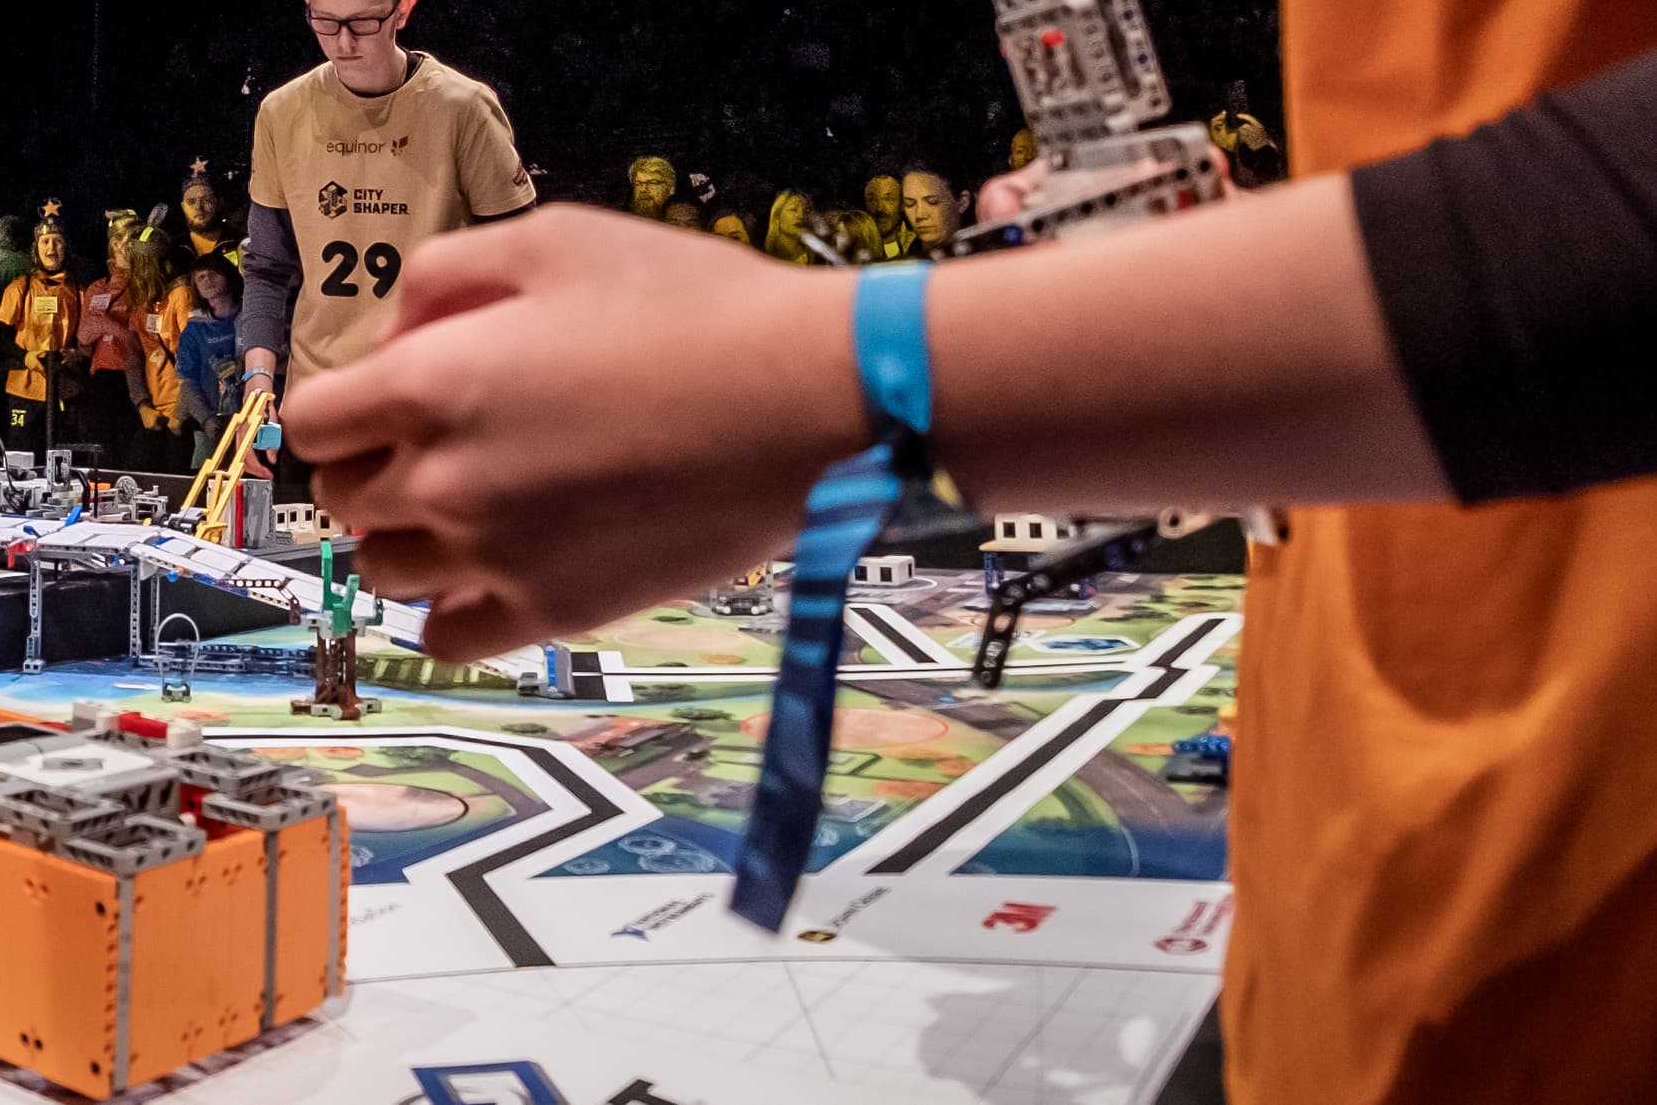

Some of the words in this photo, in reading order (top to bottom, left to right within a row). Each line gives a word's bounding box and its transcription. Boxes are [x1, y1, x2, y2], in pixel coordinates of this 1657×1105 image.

[326, 139, 386, 156] equinor
[353, 188, 384, 201] CITY
[353, 202, 410, 215] SHAPER
[321, 240, 402, 299] 29
[11, 413, 25, 427] 34
